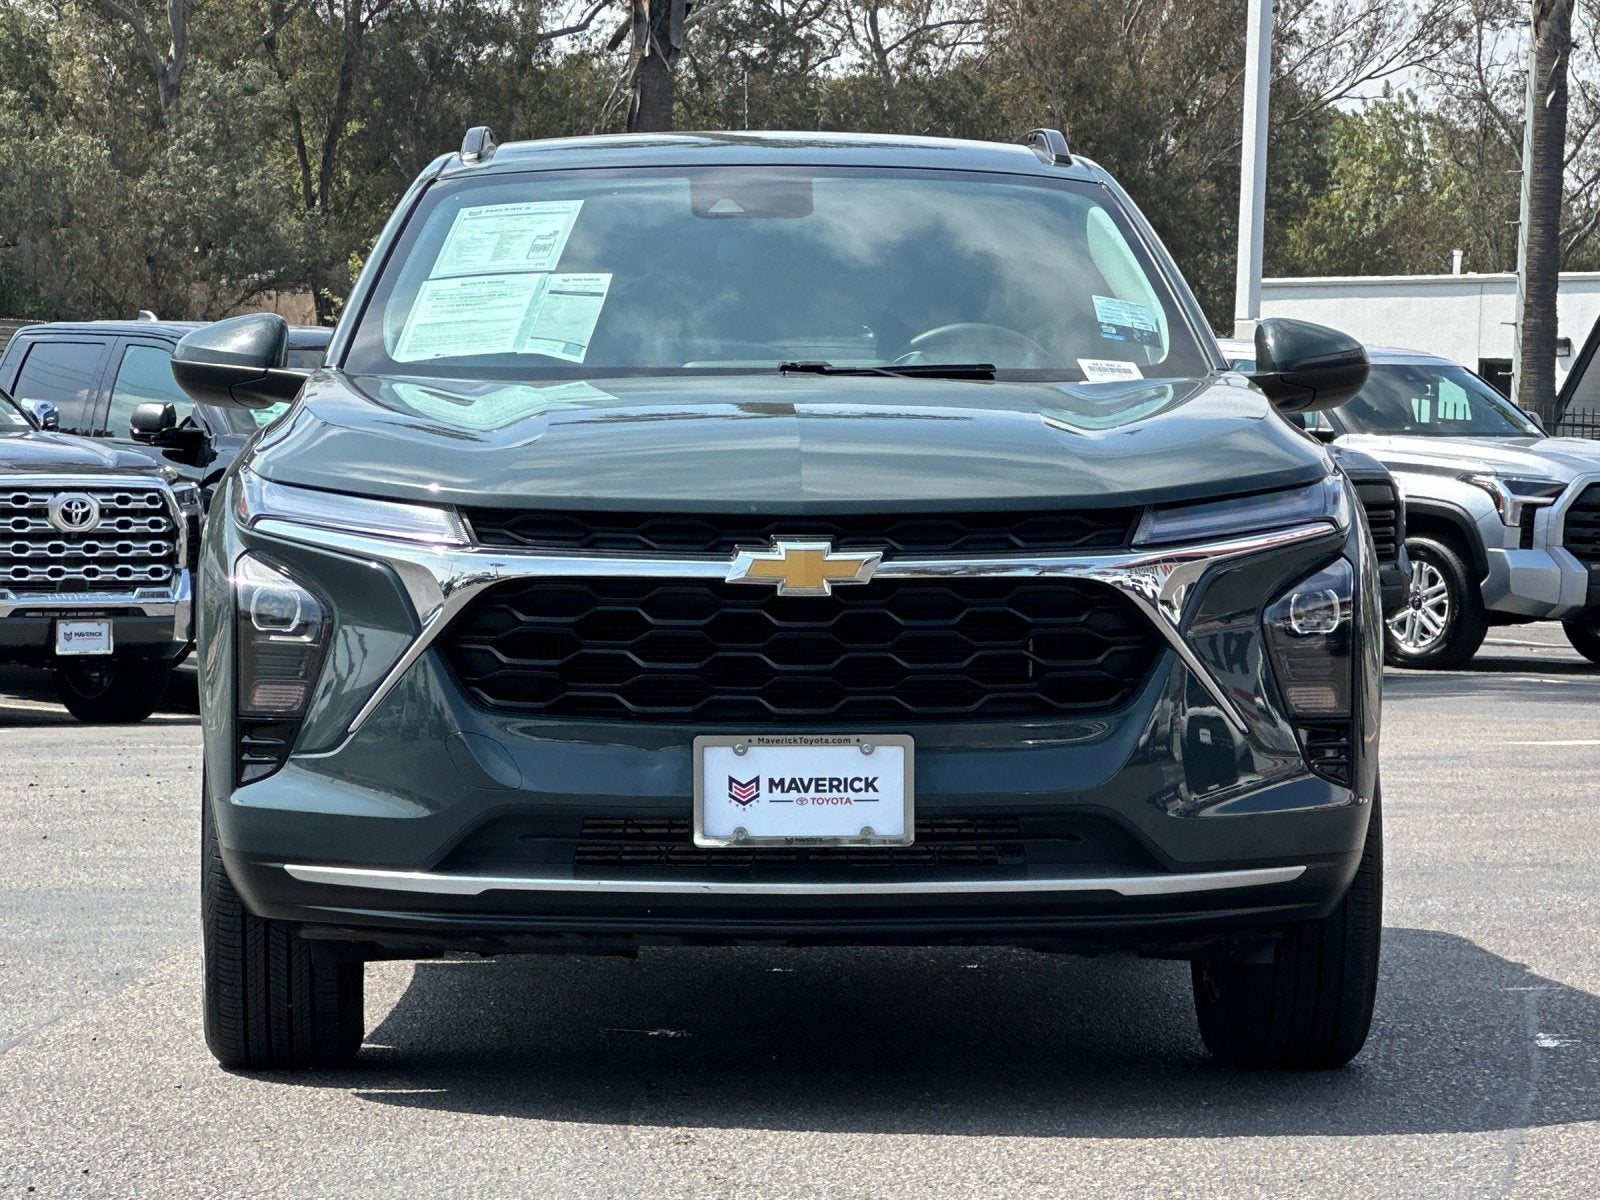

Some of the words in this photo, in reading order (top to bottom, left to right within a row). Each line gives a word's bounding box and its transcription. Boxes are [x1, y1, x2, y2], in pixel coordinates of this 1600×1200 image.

[757, 737, 851, 745] MaverickToyota.com
[768, 777, 879, 793] MAVERICK
[810, 797, 852, 805] TOYOTA
